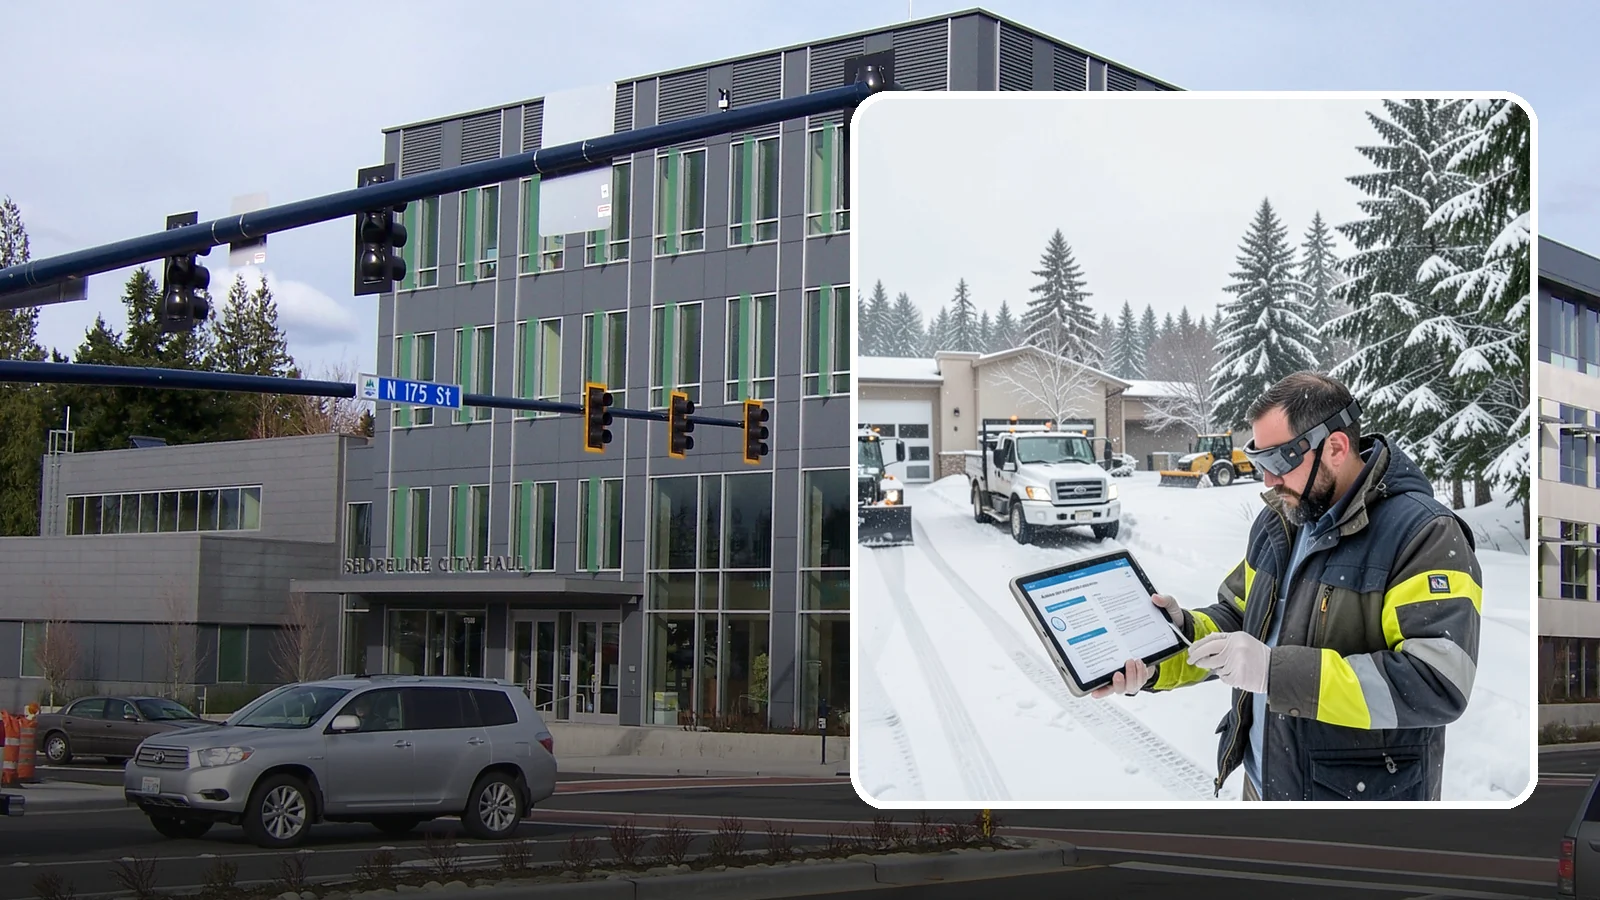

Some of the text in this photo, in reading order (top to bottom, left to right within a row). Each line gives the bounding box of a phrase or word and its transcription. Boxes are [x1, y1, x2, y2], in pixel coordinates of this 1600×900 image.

[387, 381, 451, 405] N 175 St
[344, 555, 526, 574] SHORELINE CITY HALL
